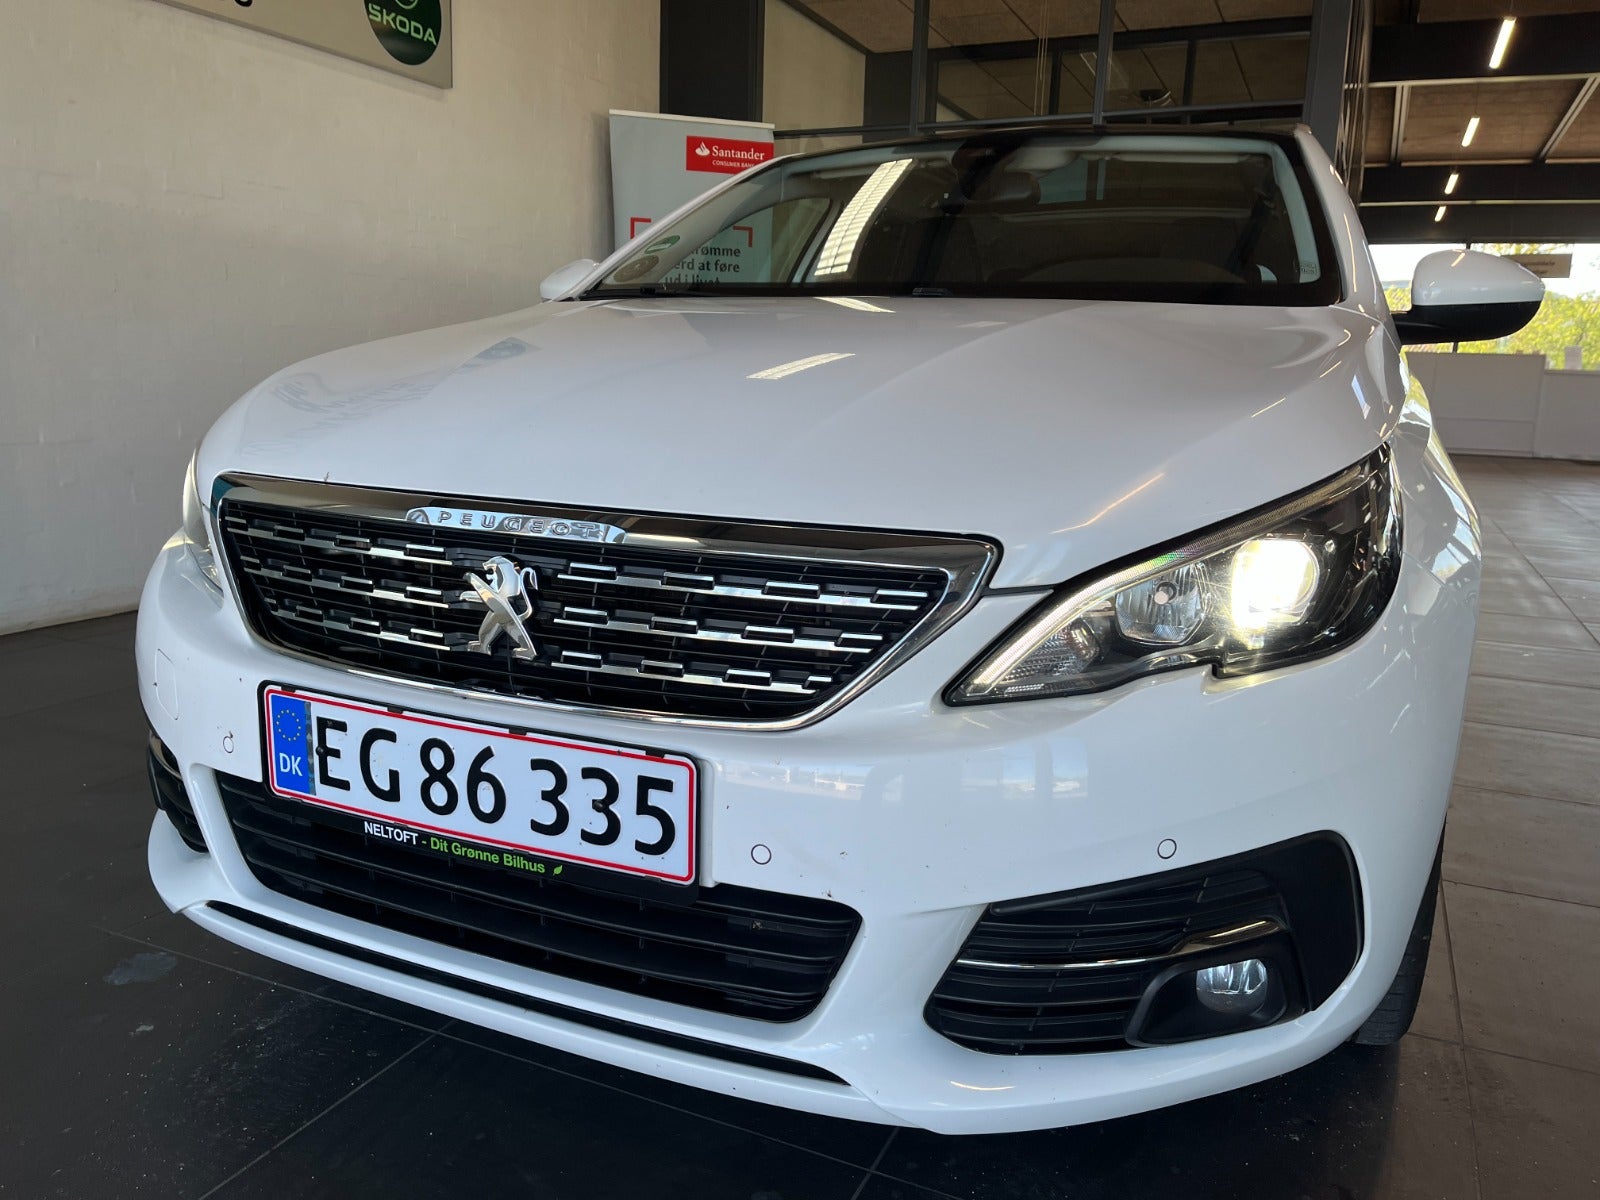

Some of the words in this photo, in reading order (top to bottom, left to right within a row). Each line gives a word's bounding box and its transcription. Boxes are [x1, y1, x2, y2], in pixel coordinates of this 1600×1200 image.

[712, 145, 765, 160] Santander
[712, 160, 740, 168] CONSUMER
[698, 261, 711, 271] at
[714, 259, 740, 272] føre
[437, 511, 597, 538] PEUGEOT
[279, 752, 302, 777] DK
[316, 716, 401, 802] EG
[419, 737, 507, 824] 86
[530, 758, 676, 855] 335
[364, 821, 418, 845] NELTOFT
[431, 837, 448, 853] Dit
[451, 842, 500, 864] Grønne
[503, 853, 546, 874] Bilhus
